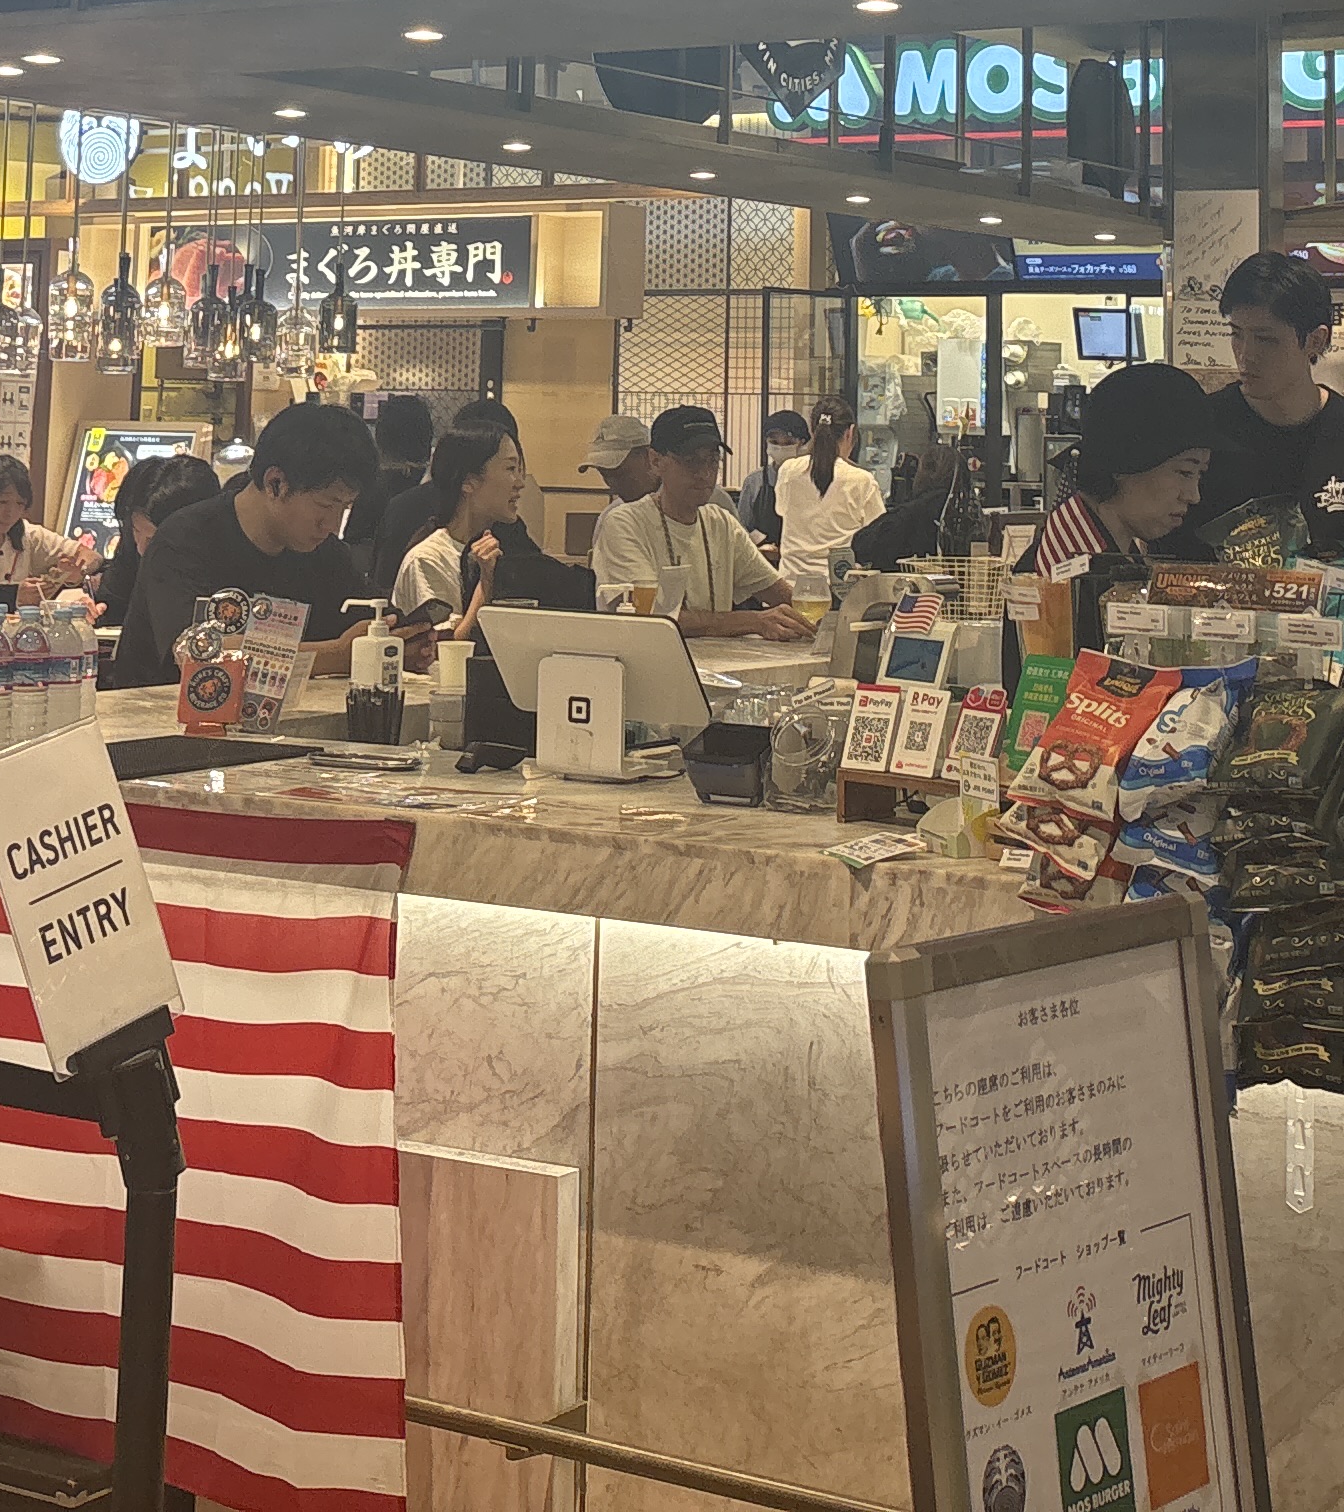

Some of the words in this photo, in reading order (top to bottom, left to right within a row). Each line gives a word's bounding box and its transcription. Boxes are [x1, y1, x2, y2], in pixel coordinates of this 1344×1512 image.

[286, 240, 504, 287] まぐろ丼専門
[868, 697, 893, 709] PayPay
[920, 692, 944, 710] Pay
[1066, 691, 1132, 729] Splits
[6, 802, 122, 880] CASHIER
[1143, 832, 1177, 852] Original
[38, 886, 131, 965] ENTRY
[1017, 999, 1081, 1028] お客さま各位
[1132, 1265, 1184, 1305] Mighty
[1141, 1293, 1173, 1337] Leaf
[1092, 1480, 1132, 1507] BURGER
